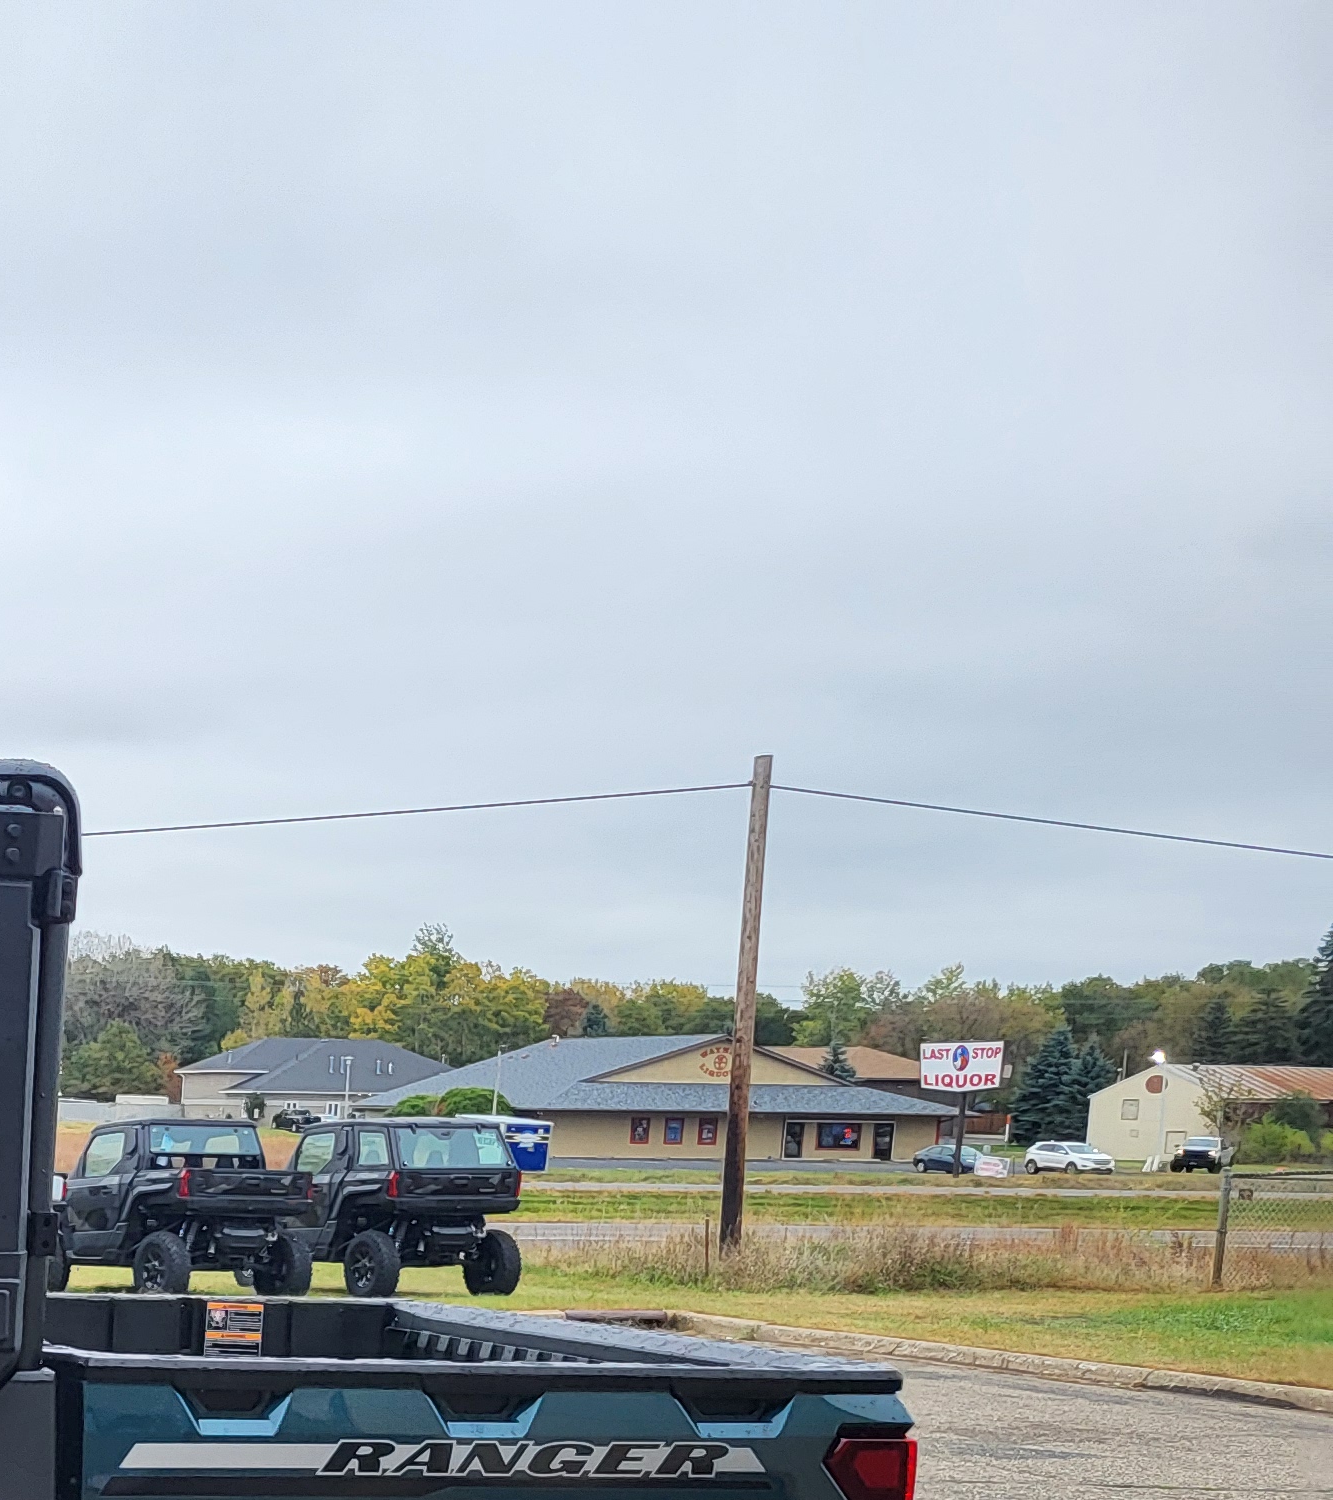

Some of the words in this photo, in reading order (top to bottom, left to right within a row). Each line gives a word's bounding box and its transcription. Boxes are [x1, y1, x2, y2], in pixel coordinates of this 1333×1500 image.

[922, 1048, 951, 1060] LAST
[972, 1047, 1001, 1059] STOP
[699, 1063, 729, 1077] LIQUO
[923, 1074, 997, 1088] LIQUOR
[315, 1439, 731, 1479] RANGER
